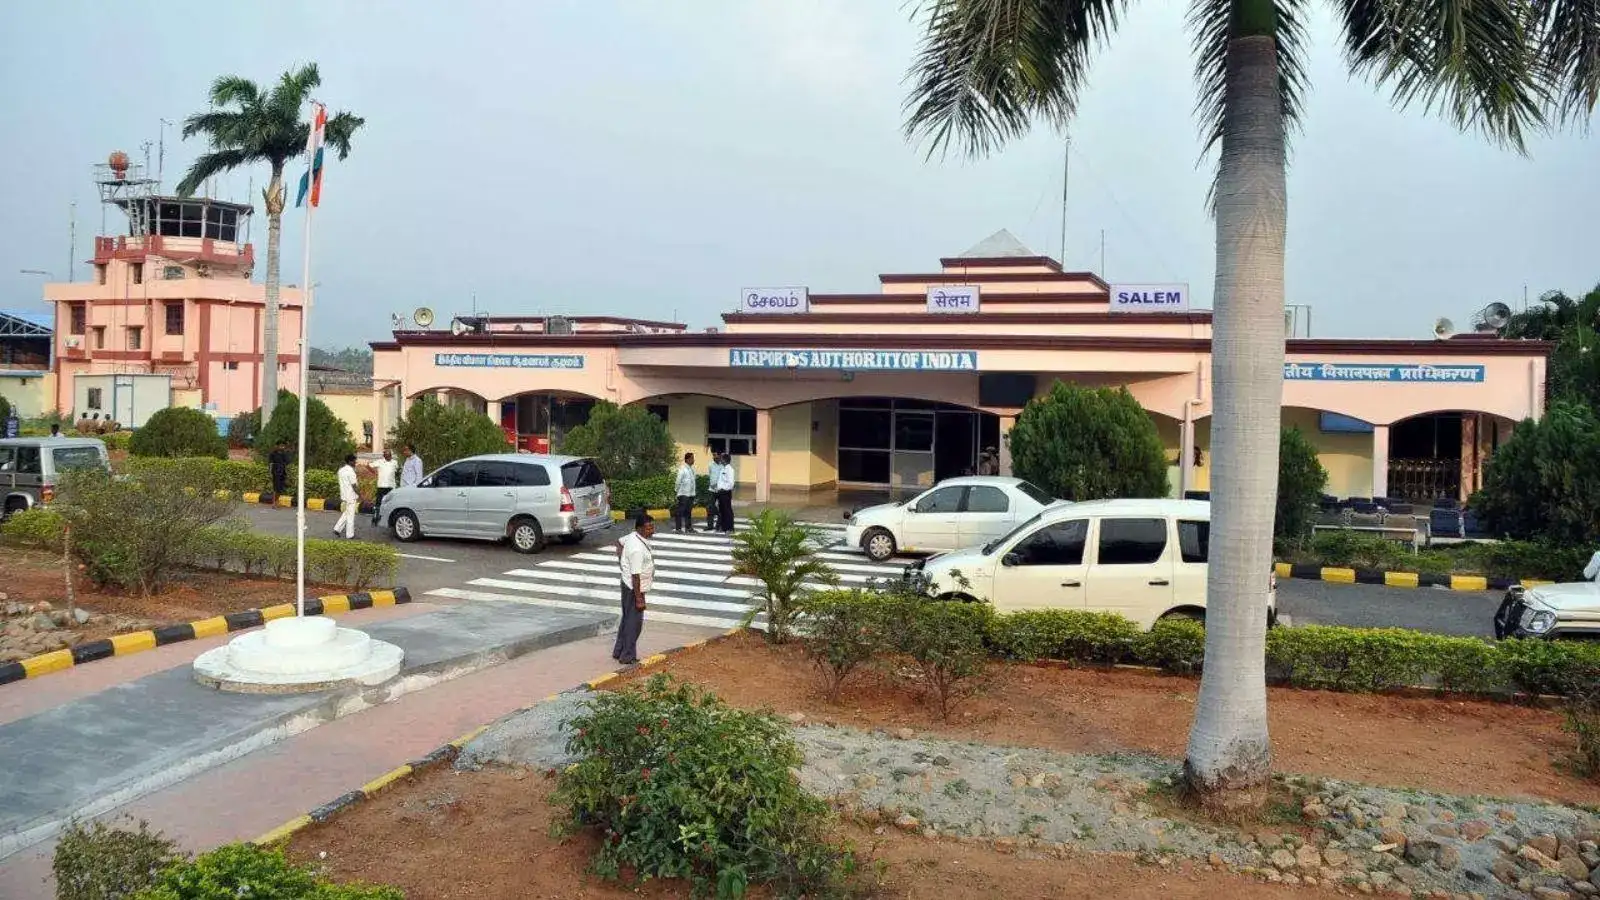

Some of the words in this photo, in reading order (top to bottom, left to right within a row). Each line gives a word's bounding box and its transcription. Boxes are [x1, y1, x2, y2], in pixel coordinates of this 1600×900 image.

[747, 291, 799, 308] சேலம்
[933, 291, 971, 307] सेलम
[1118, 292, 1181, 304] SALEM
[732, 350, 808, 366] AIRPORTS
[810, 351, 902, 368] AUTHORITY
[901, 352, 920, 368] OF
[921, 352, 974, 369] INDIA
